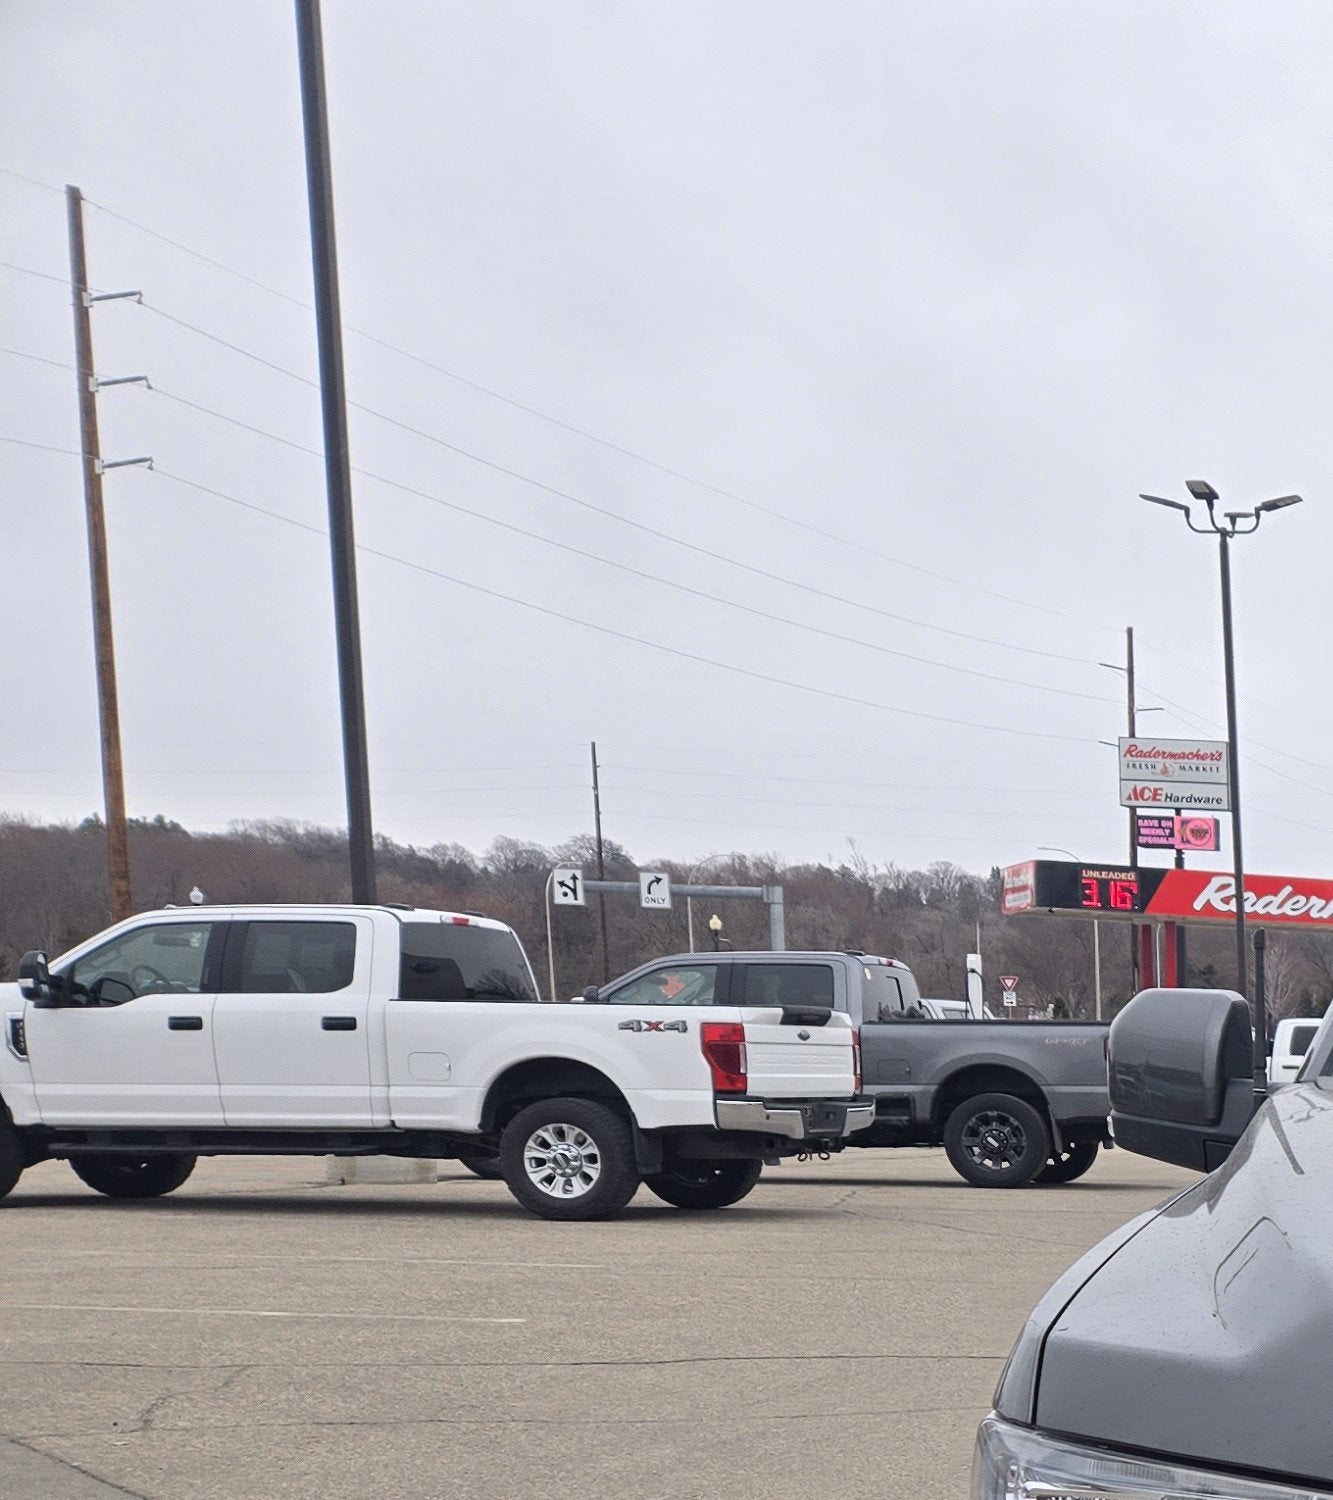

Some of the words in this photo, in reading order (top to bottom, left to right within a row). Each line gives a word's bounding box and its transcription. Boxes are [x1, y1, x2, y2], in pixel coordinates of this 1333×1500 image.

[1123, 743, 1223, 761] Radermacher's
[1179, 764, 1220, 774] MARKET
[1126, 784, 1163, 802] ACE
[1164, 792, 1223, 805] Hardware
[1082, 868, 1137, 880] UNLEADED
[644, 896, 667, 905] ONLY
